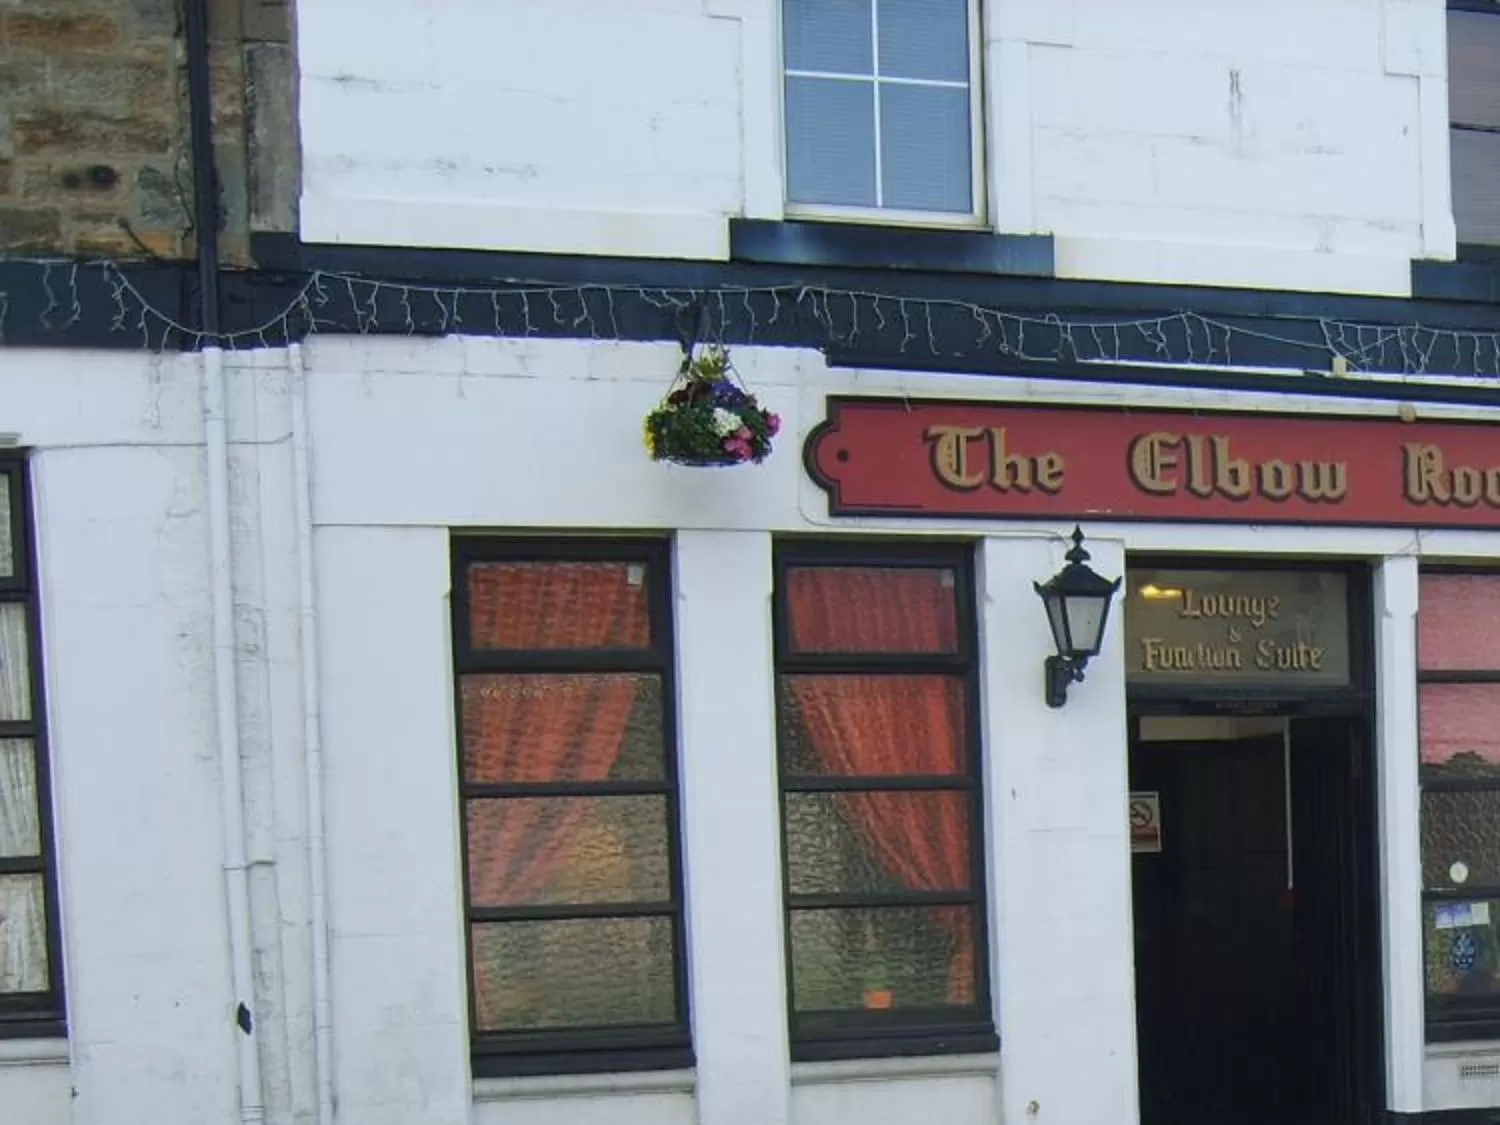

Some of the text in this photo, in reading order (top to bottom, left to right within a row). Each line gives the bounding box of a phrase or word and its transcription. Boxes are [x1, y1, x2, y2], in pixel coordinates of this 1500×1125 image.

[926, 422, 1064, 495] The
[1129, 430, 1349, 502] Elbow
[1180, 587, 1281, 628] Lounge
[1228, 625, 1243, 643] &
[1140, 637, 1329, 672] Function Suite
